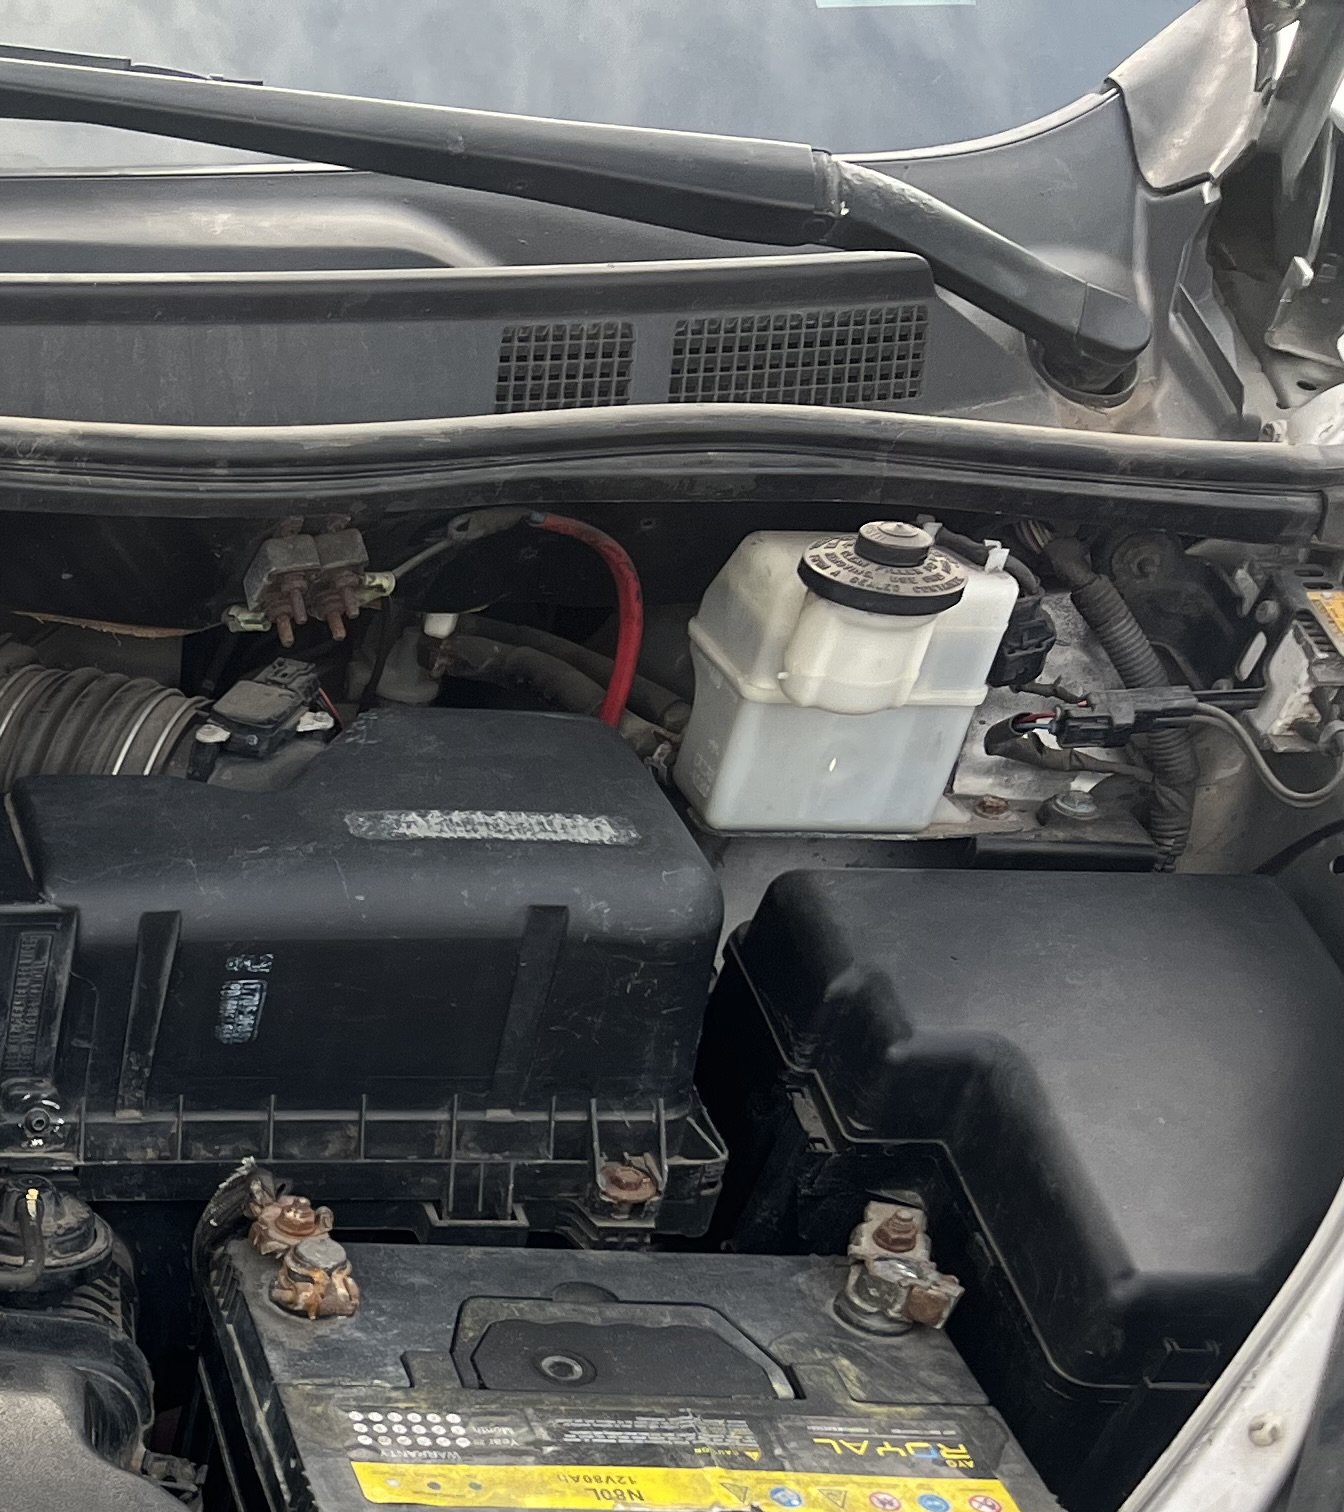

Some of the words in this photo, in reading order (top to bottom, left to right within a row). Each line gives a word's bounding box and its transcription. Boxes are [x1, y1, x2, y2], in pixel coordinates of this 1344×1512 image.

[472, 1426, 515, 1436] Month
[488, 1438, 519, 1448] Year
[812, 1437, 971, 1460] ROYAL
[379, 1448, 462, 1460] WARRANTY
[584, 1487, 645, 1502] N80L
